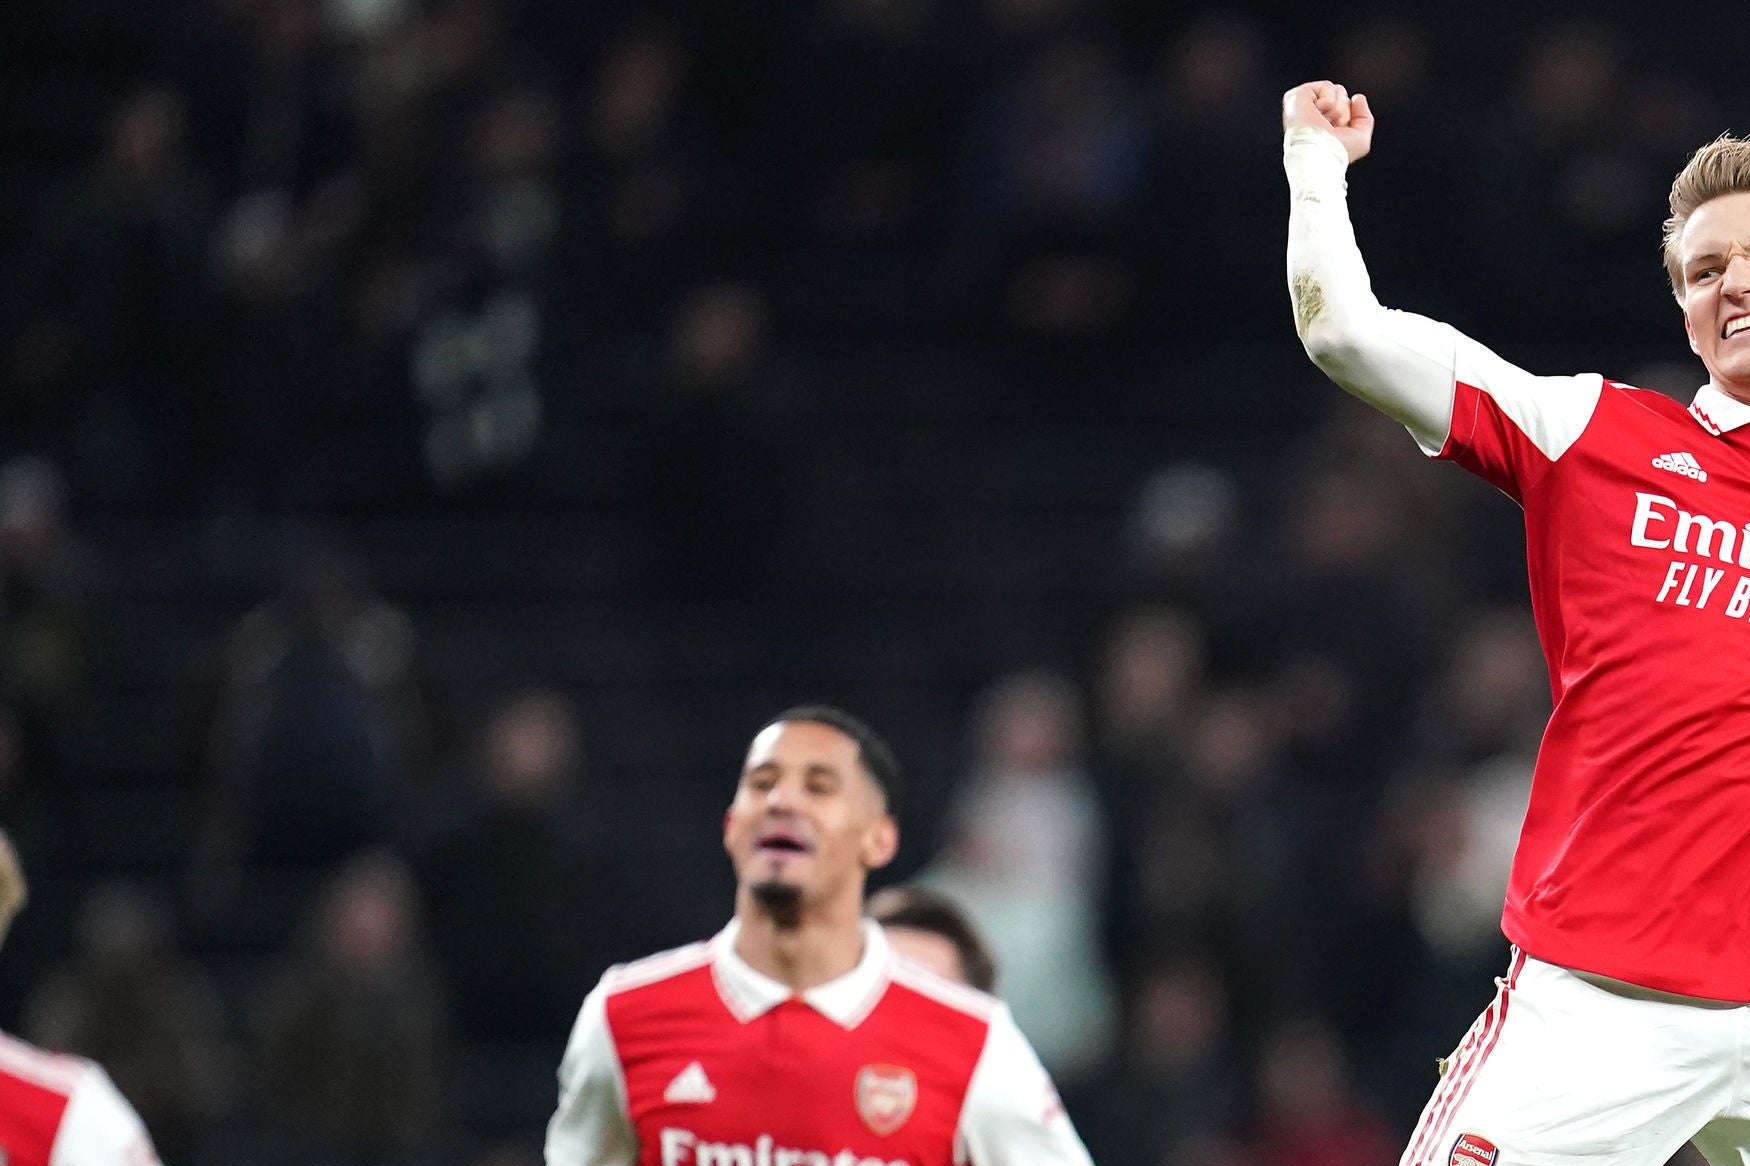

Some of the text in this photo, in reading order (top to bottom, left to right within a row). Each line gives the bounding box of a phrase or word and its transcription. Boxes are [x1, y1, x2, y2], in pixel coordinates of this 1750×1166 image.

[1651, 457, 1708, 483] adidas
[1655, 560, 1725, 610] FLY
[1458, 1139, 1494, 1160] Arsenal
